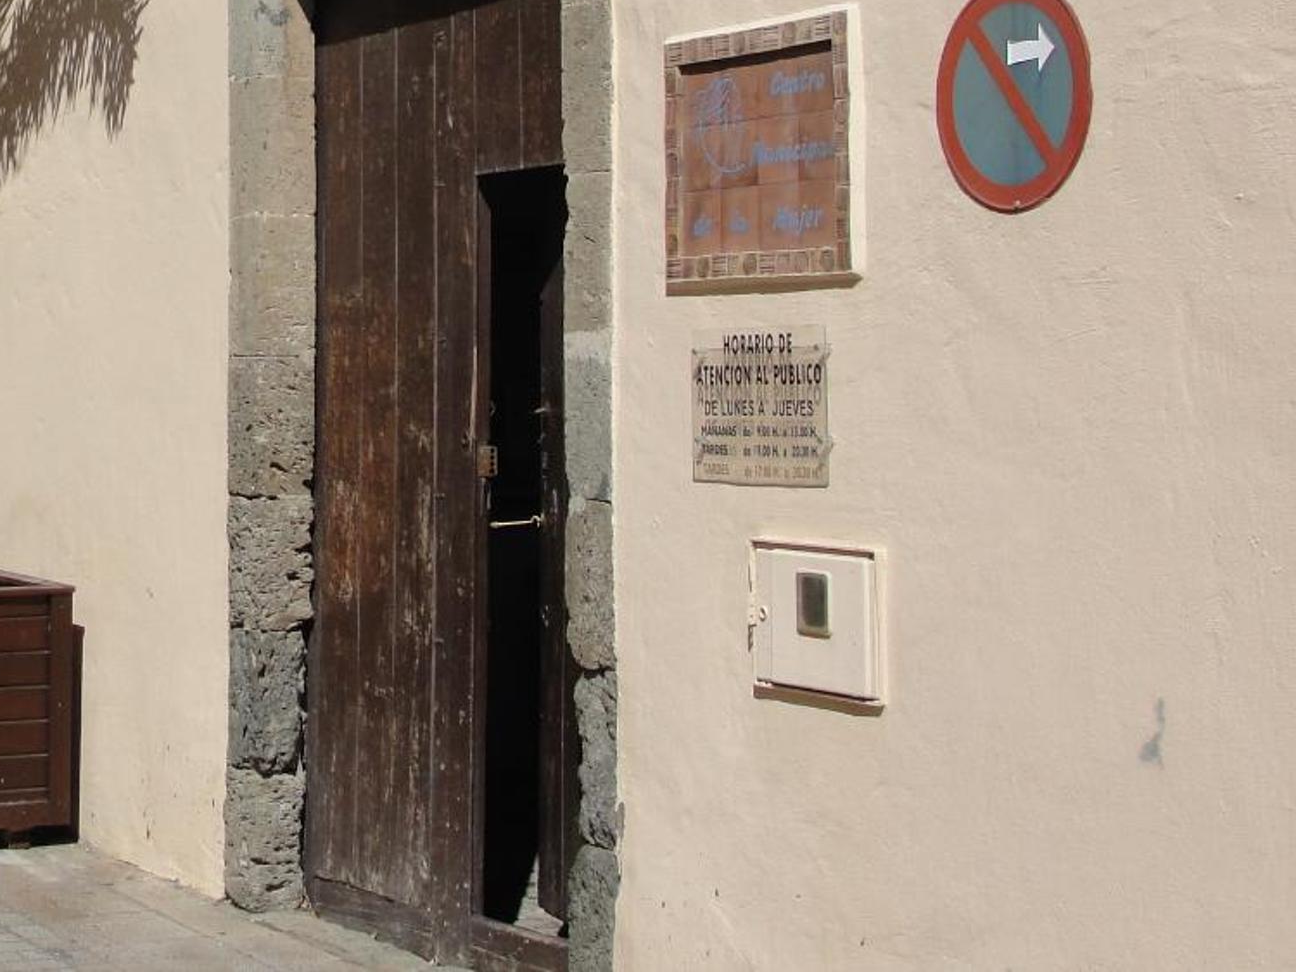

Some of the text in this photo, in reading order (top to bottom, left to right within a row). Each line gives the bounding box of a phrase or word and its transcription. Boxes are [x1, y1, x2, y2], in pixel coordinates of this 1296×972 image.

[723, 332, 793, 356] HORARIO DE
[696, 363, 822, 386] ATENCION AL PUBLICO
[704, 399, 815, 417] DE LUNES A JUEVES
